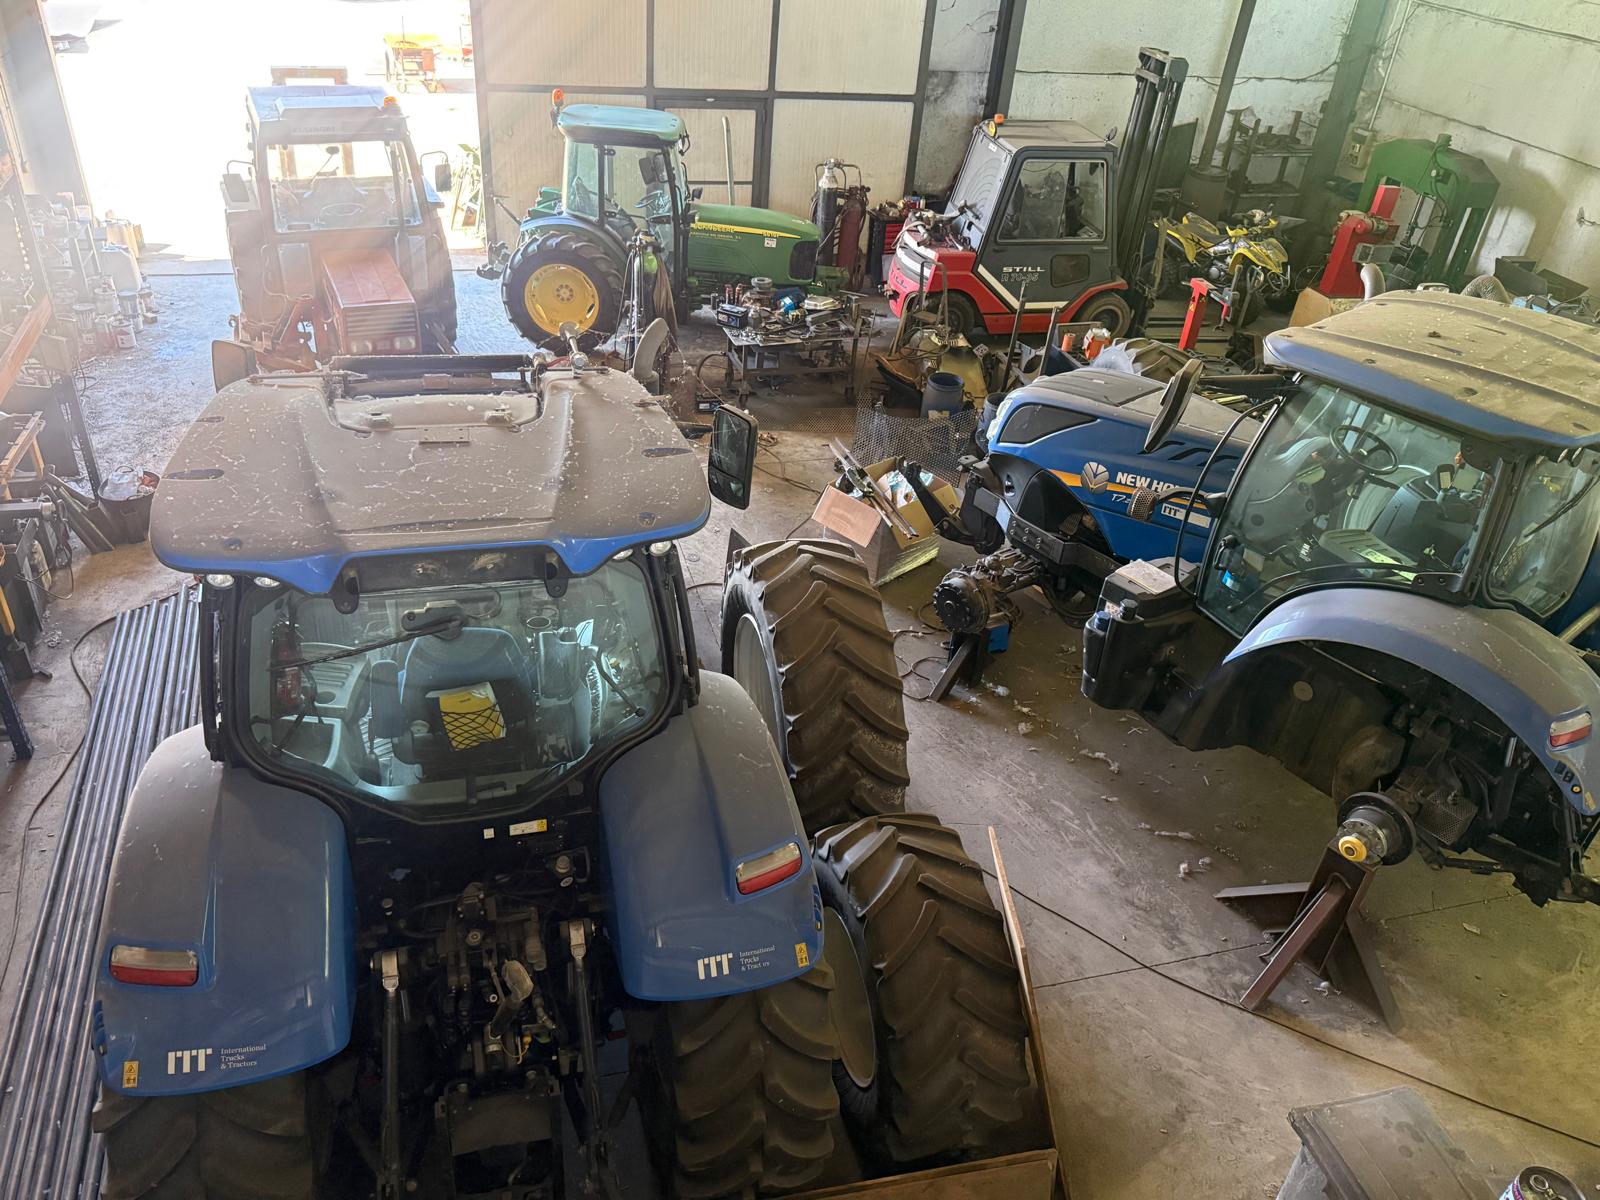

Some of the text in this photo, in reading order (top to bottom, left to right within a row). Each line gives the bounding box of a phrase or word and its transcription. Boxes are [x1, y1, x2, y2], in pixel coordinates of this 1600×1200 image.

[1116, 471, 1152, 489] NEW
[740, 945, 776, 957] International
[740, 956, 760, 965] Trucks
[747, 961, 770, 971] Tractrs
[220, 1043, 267, 1055] International
[221, 1054, 245, 1062] Trucks
[228, 1060, 257, 1069] Tractors
